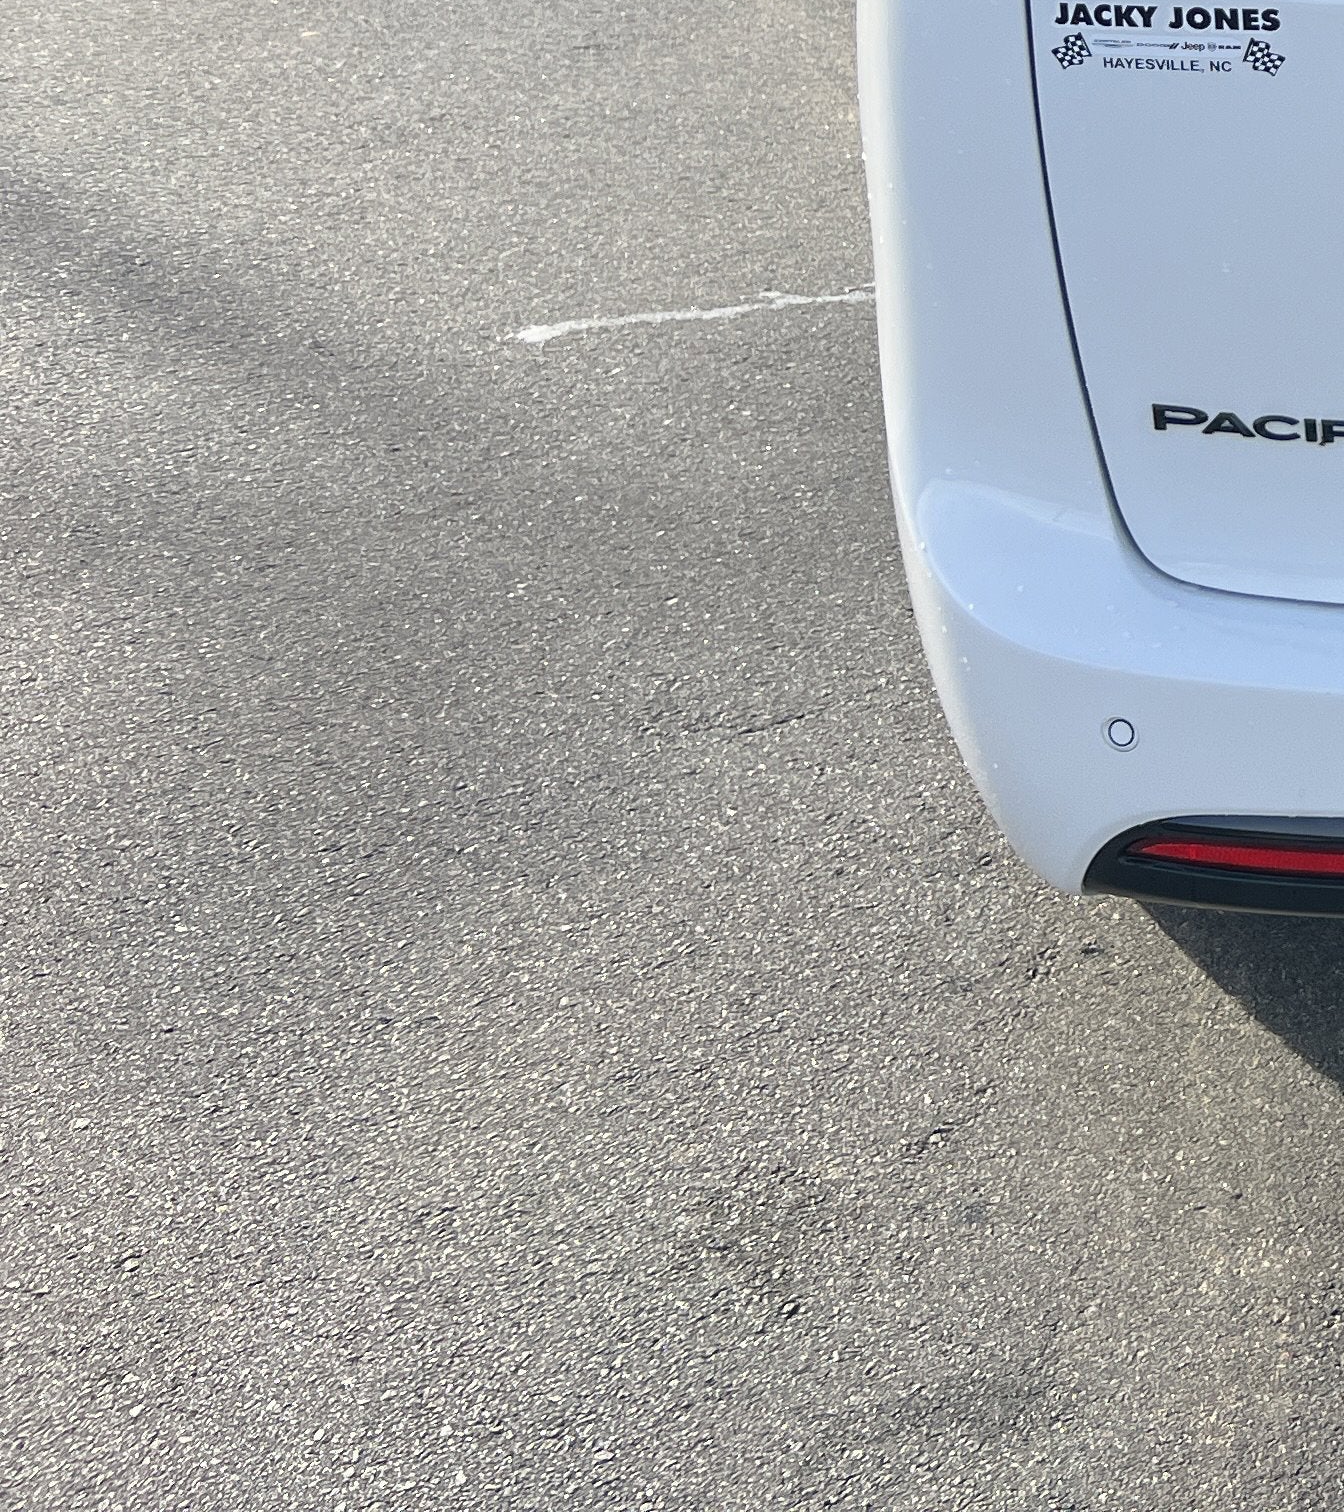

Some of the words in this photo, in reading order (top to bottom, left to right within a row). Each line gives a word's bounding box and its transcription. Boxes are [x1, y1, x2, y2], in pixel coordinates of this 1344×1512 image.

[1054, 2, 1158, 28] JACKY
[1169, 7, 1281, 31] JONES
[1181, 41, 1206, 52] Jeep
[1102, 56, 1206, 73] HAYESVILLE,
[1209, 60, 1233, 73] NC
